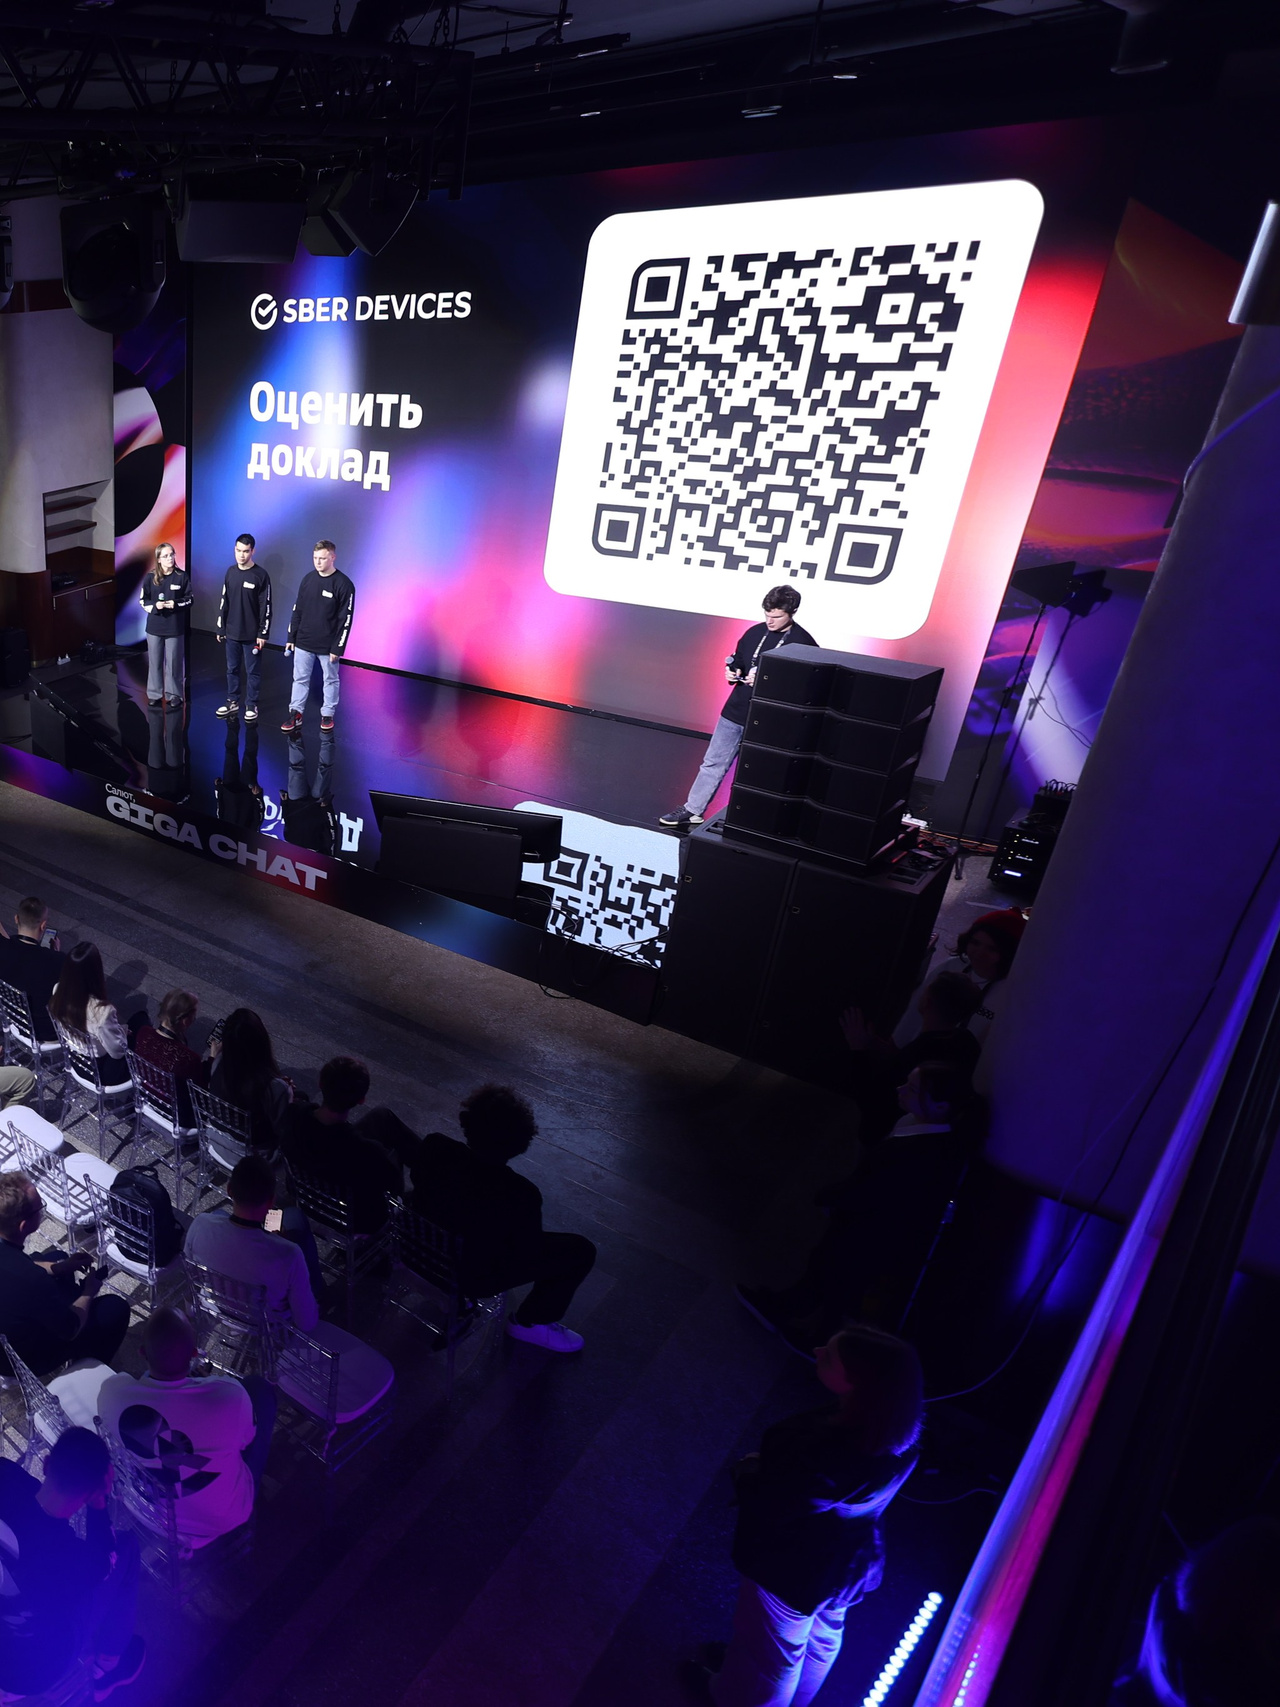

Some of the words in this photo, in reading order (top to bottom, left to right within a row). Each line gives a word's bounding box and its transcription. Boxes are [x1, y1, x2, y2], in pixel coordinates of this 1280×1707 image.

[282, 297, 348, 323] SBER
[355, 291, 472, 321] DEVICES
[249, 381, 423, 430] Оценить
[247, 443, 391, 491] доклад
[105, 782, 136, 803] Салют,
[105, 796, 204, 850] GIGA
[208, 833, 328, 891] CHAT
